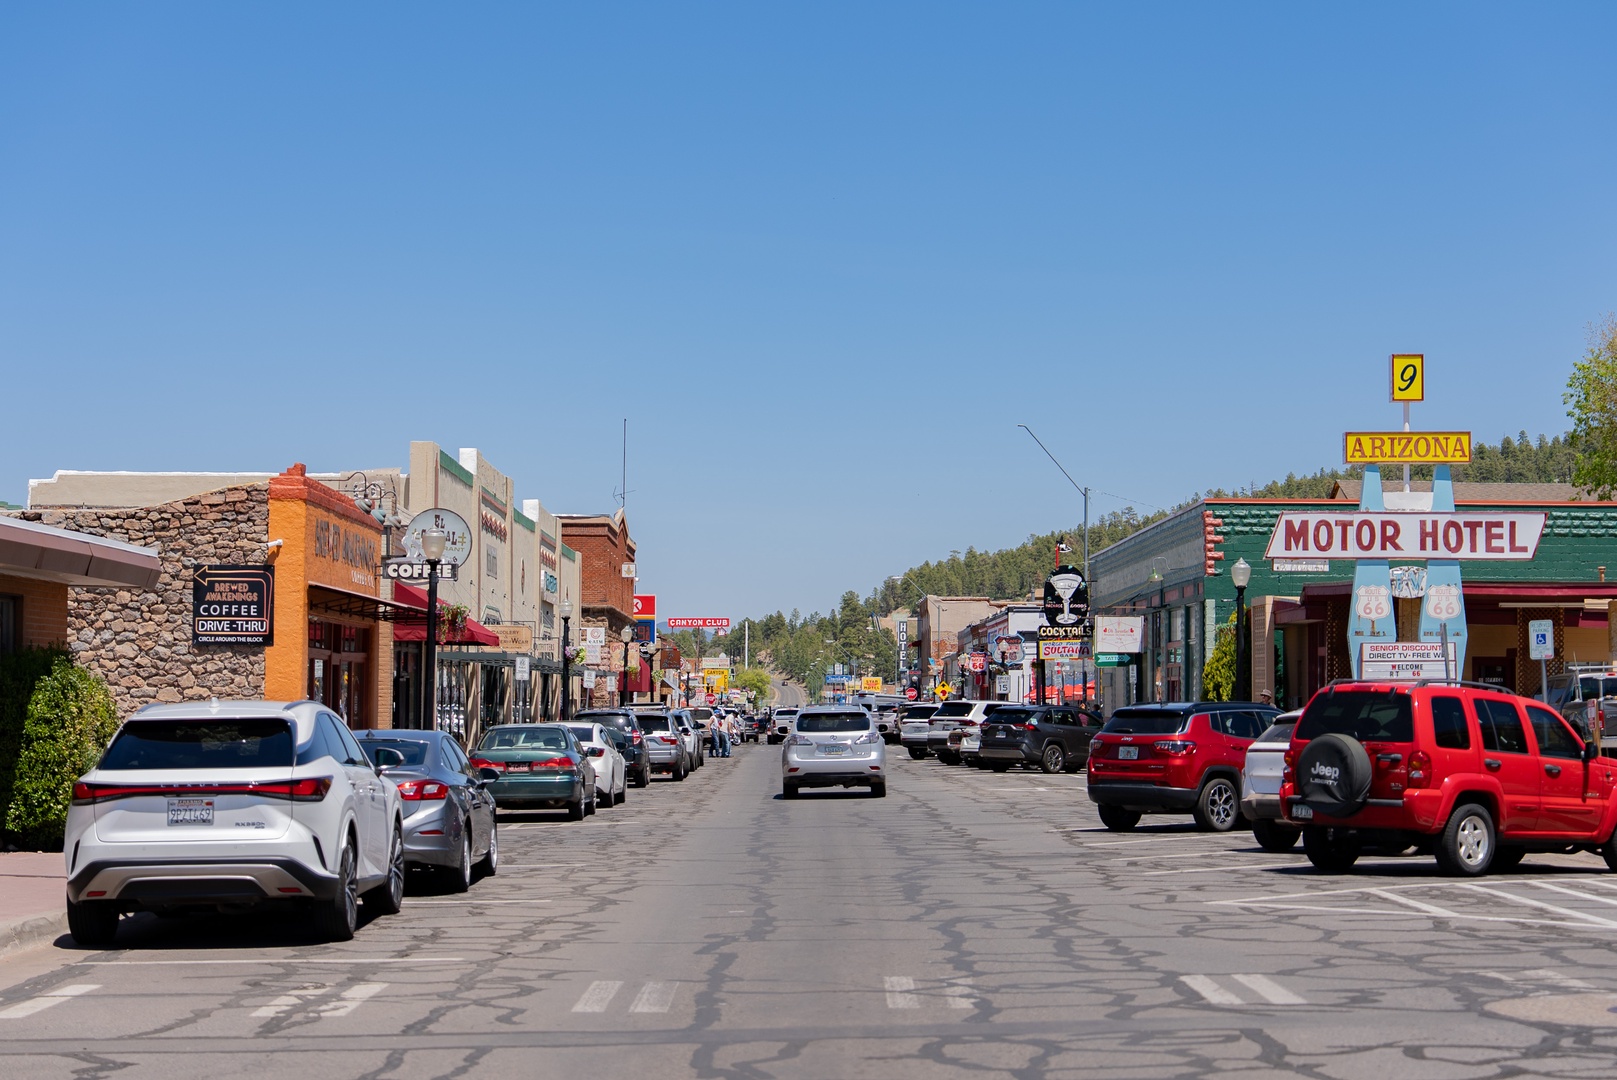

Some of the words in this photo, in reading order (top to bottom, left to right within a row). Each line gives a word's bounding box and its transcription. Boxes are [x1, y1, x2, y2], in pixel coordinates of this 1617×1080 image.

[1398, 364, 1417, 391] 9
[1350, 436, 1468, 458] ARIZONA
[1285, 519, 1404, 553] MOTOR
[1419, 519, 1529, 554] HOTEL
[214, 582, 249, 592] BREWED
[204, 592, 258, 602] AWAKENINGS
[199, 604, 258, 616] COFFEE
[1363, 602, 1384, 615] 66
[1433, 602, 1455, 615] 66
[198, 620, 231, 631] DRIVE
[1040, 627, 1092, 636] COCKTAILS
[899, 622, 907, 671] HOTEL
[1044, 646, 1090, 656] SULTANA
[1311, 762, 1340, 779] Jeep
[1310, 777, 1339, 787] LIBERTY
